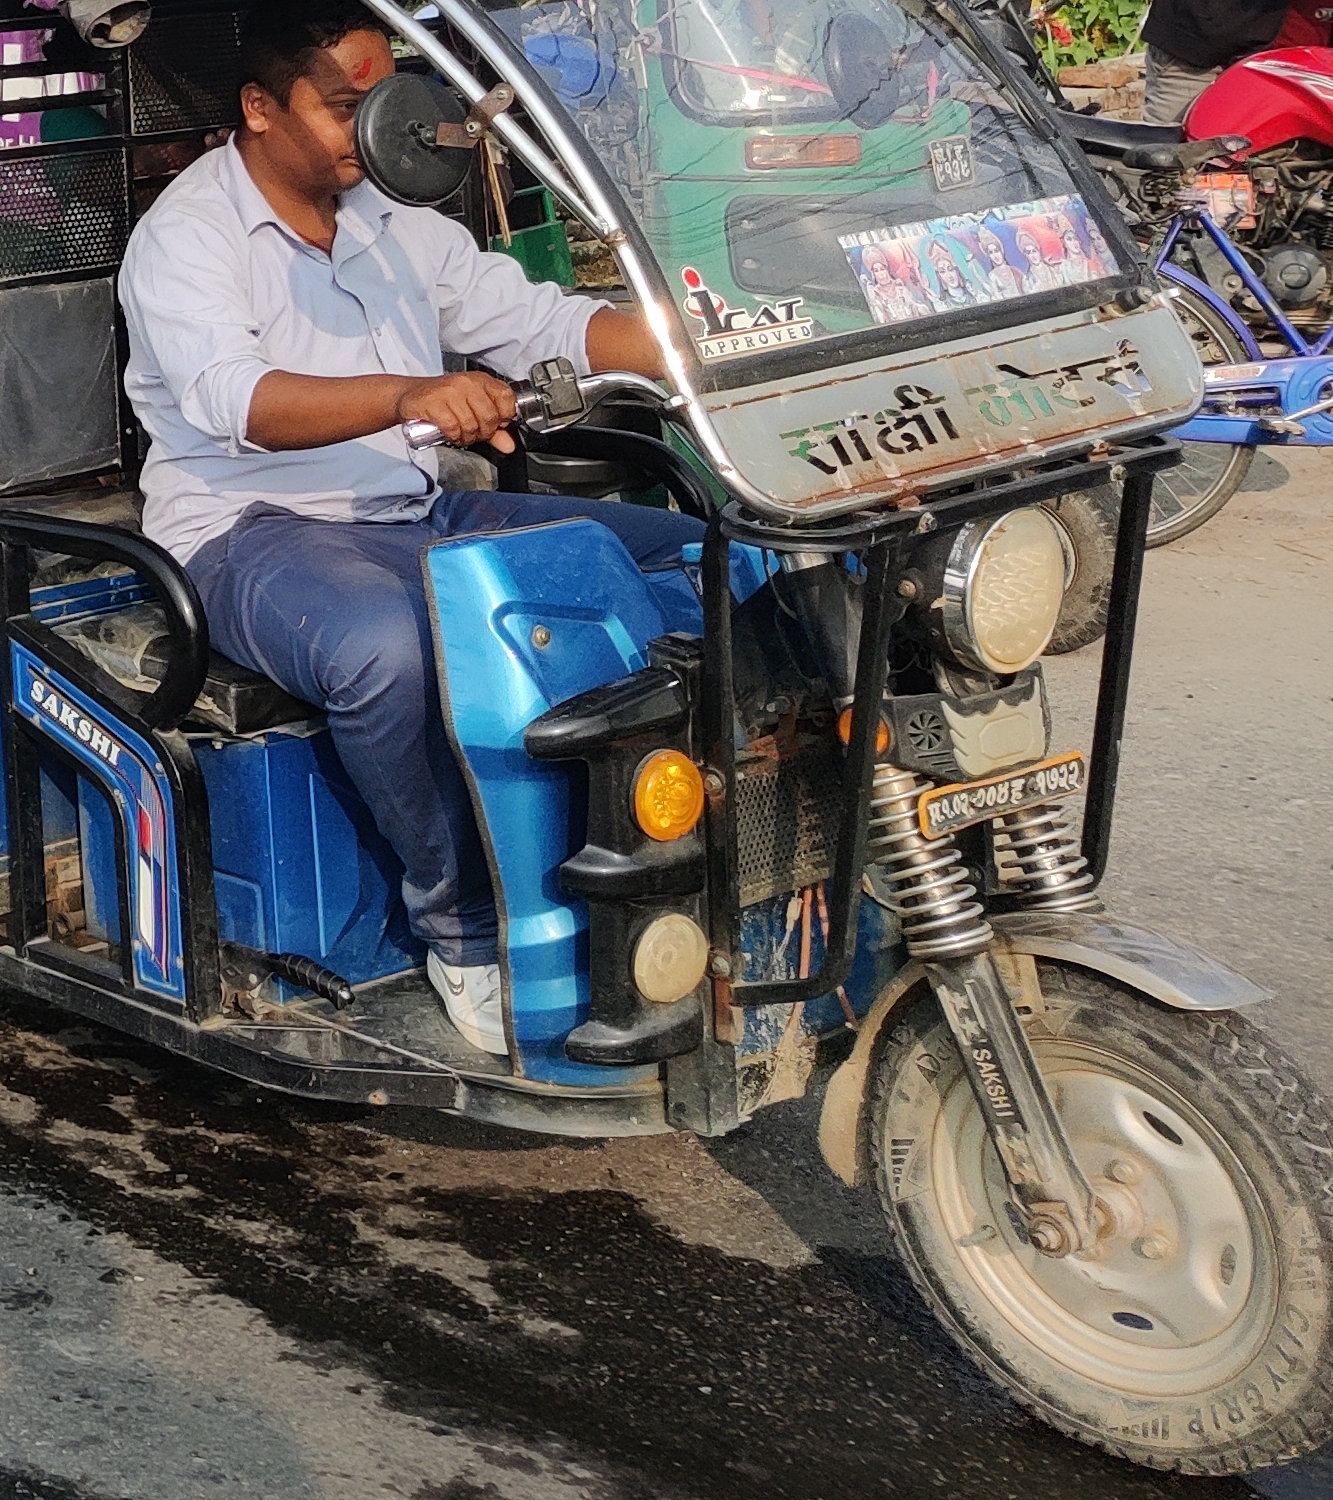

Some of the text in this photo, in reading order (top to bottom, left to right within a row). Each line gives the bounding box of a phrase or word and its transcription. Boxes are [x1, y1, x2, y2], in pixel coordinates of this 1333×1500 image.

[703, 324, 811, 357] APPROVED
[30, 678, 122, 767] SAKSHI
[972, 1048, 1015, 1118] SAKSHI
[1187, 1381, 1265, 1445] GRIP
